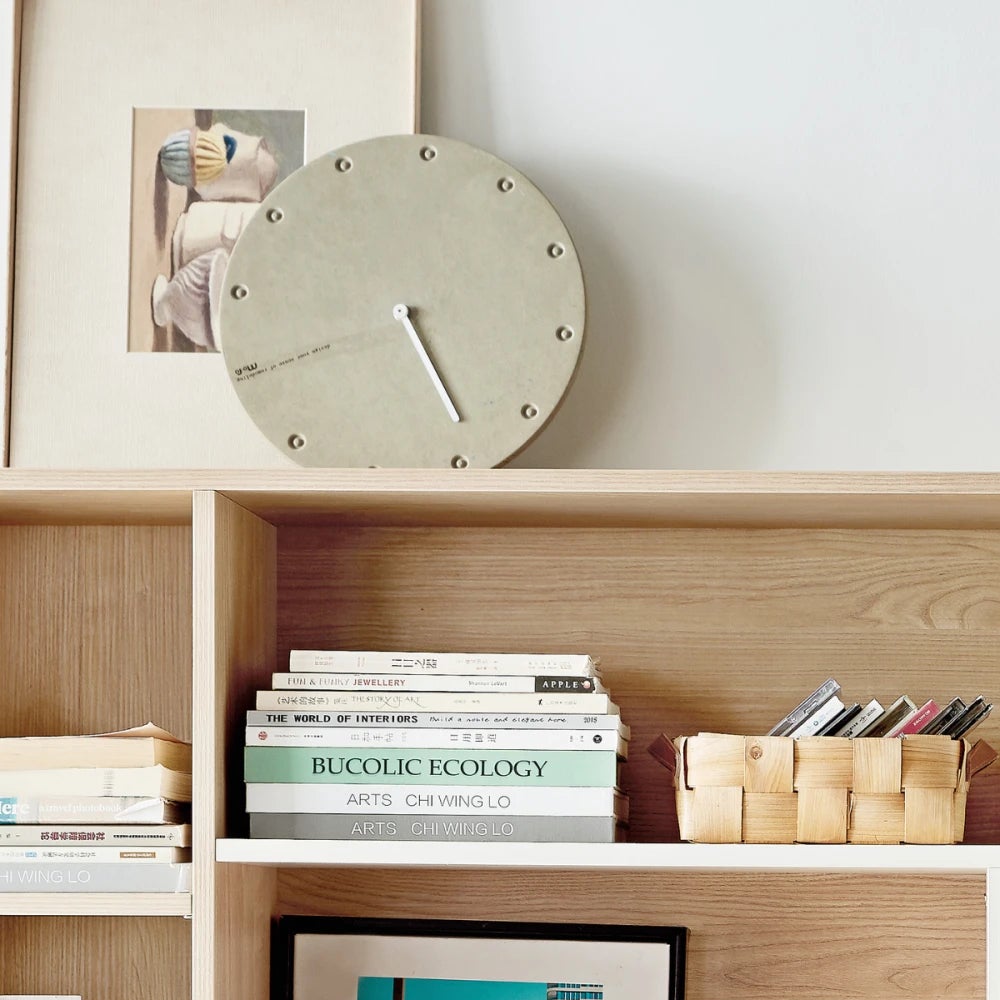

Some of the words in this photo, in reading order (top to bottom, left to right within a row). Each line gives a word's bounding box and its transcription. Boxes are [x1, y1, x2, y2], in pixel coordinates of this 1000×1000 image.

[542, 680, 579, 688] APPLE
[356, 715, 418, 723] INTERIORS
[312, 758, 422, 776] BUCOLIC
[429, 759, 548, 777] ECOLOGY
[347, 793, 392, 806] ARTS
[405, 794, 434, 807] CHI
[438, 794, 483, 808] WING
[488, 796, 511, 808] LO
[351, 822, 397, 835] ARTS
[411, 822, 438, 835] CHI
[443, 822, 487, 836] WING
[492, 822, 514, 836] LO
[17, 870, 63, 883] WING
[68, 870, 91, 883] LO
